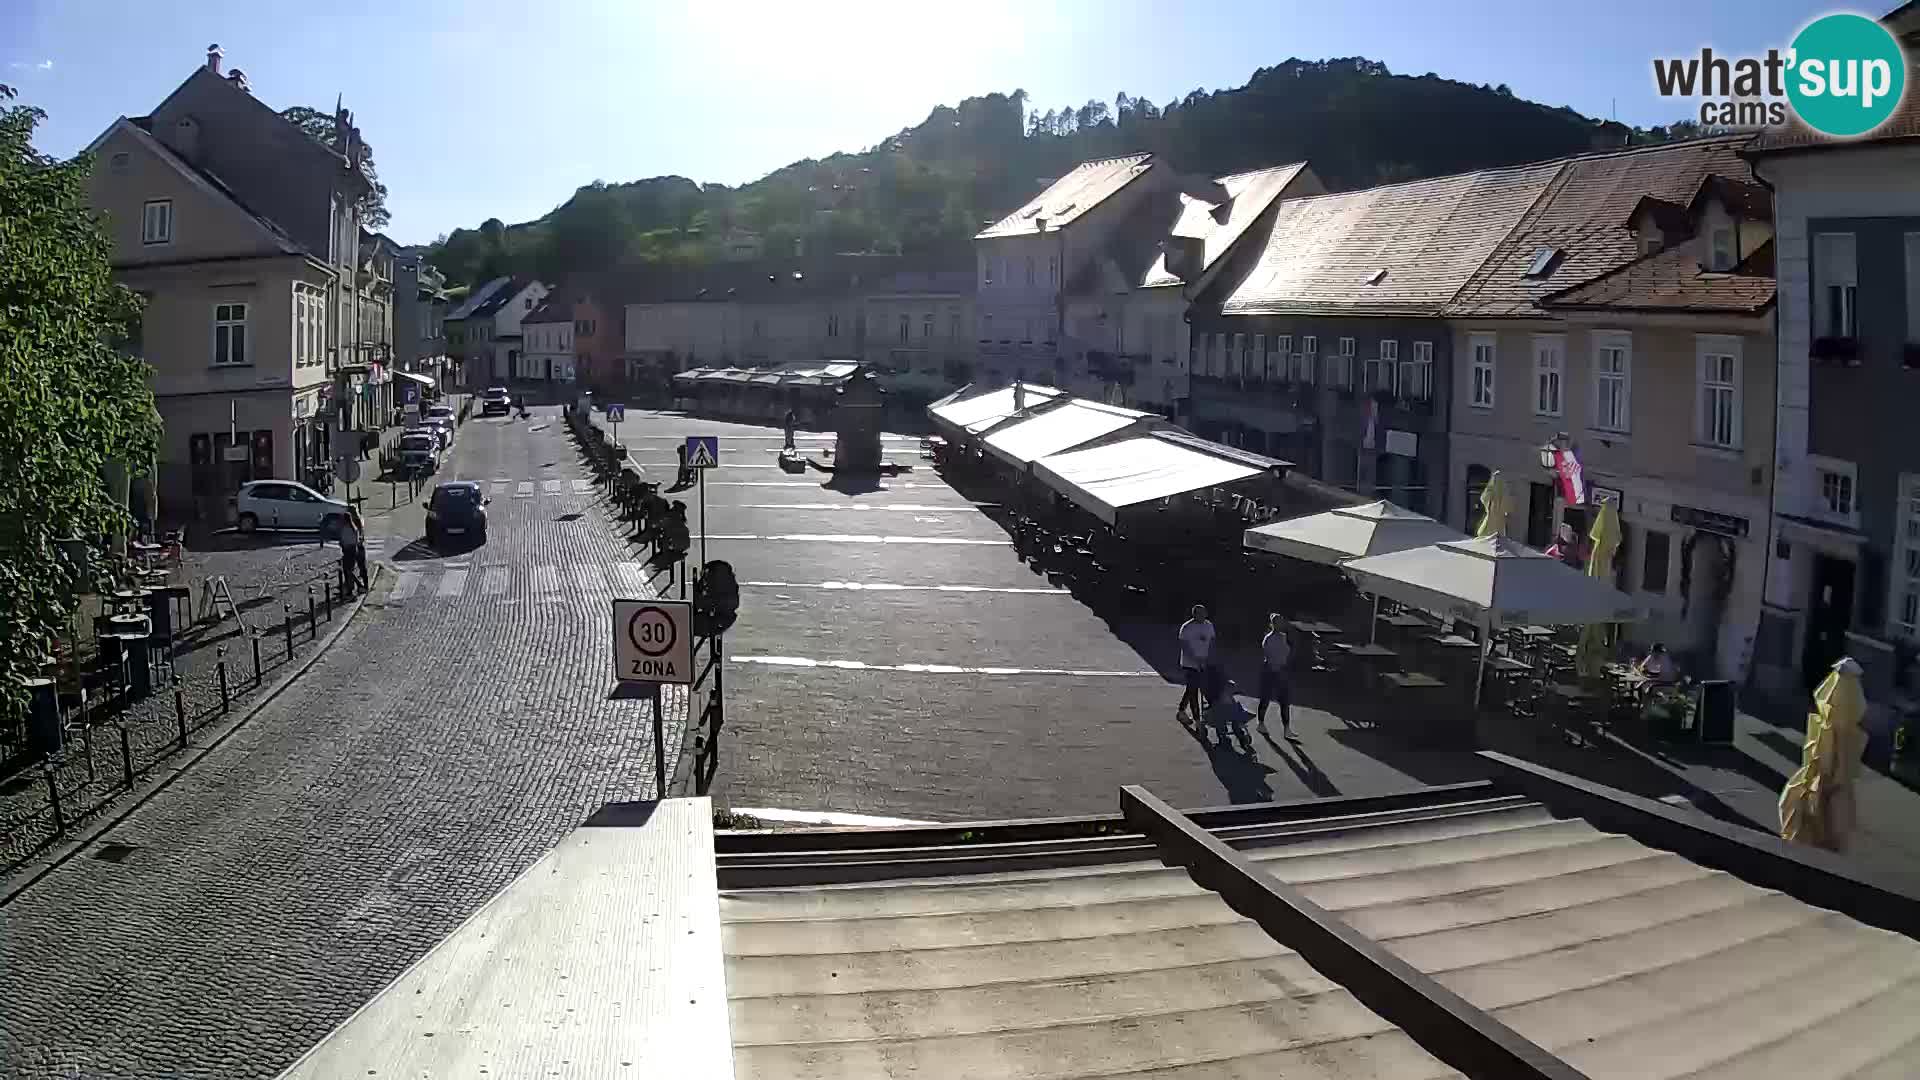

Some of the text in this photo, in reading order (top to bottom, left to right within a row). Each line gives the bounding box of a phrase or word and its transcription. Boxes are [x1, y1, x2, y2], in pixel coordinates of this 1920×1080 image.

[407, 390, 416, 401] P
[641, 622, 665, 643] 30
[631, 659, 676, 677] ZONA
